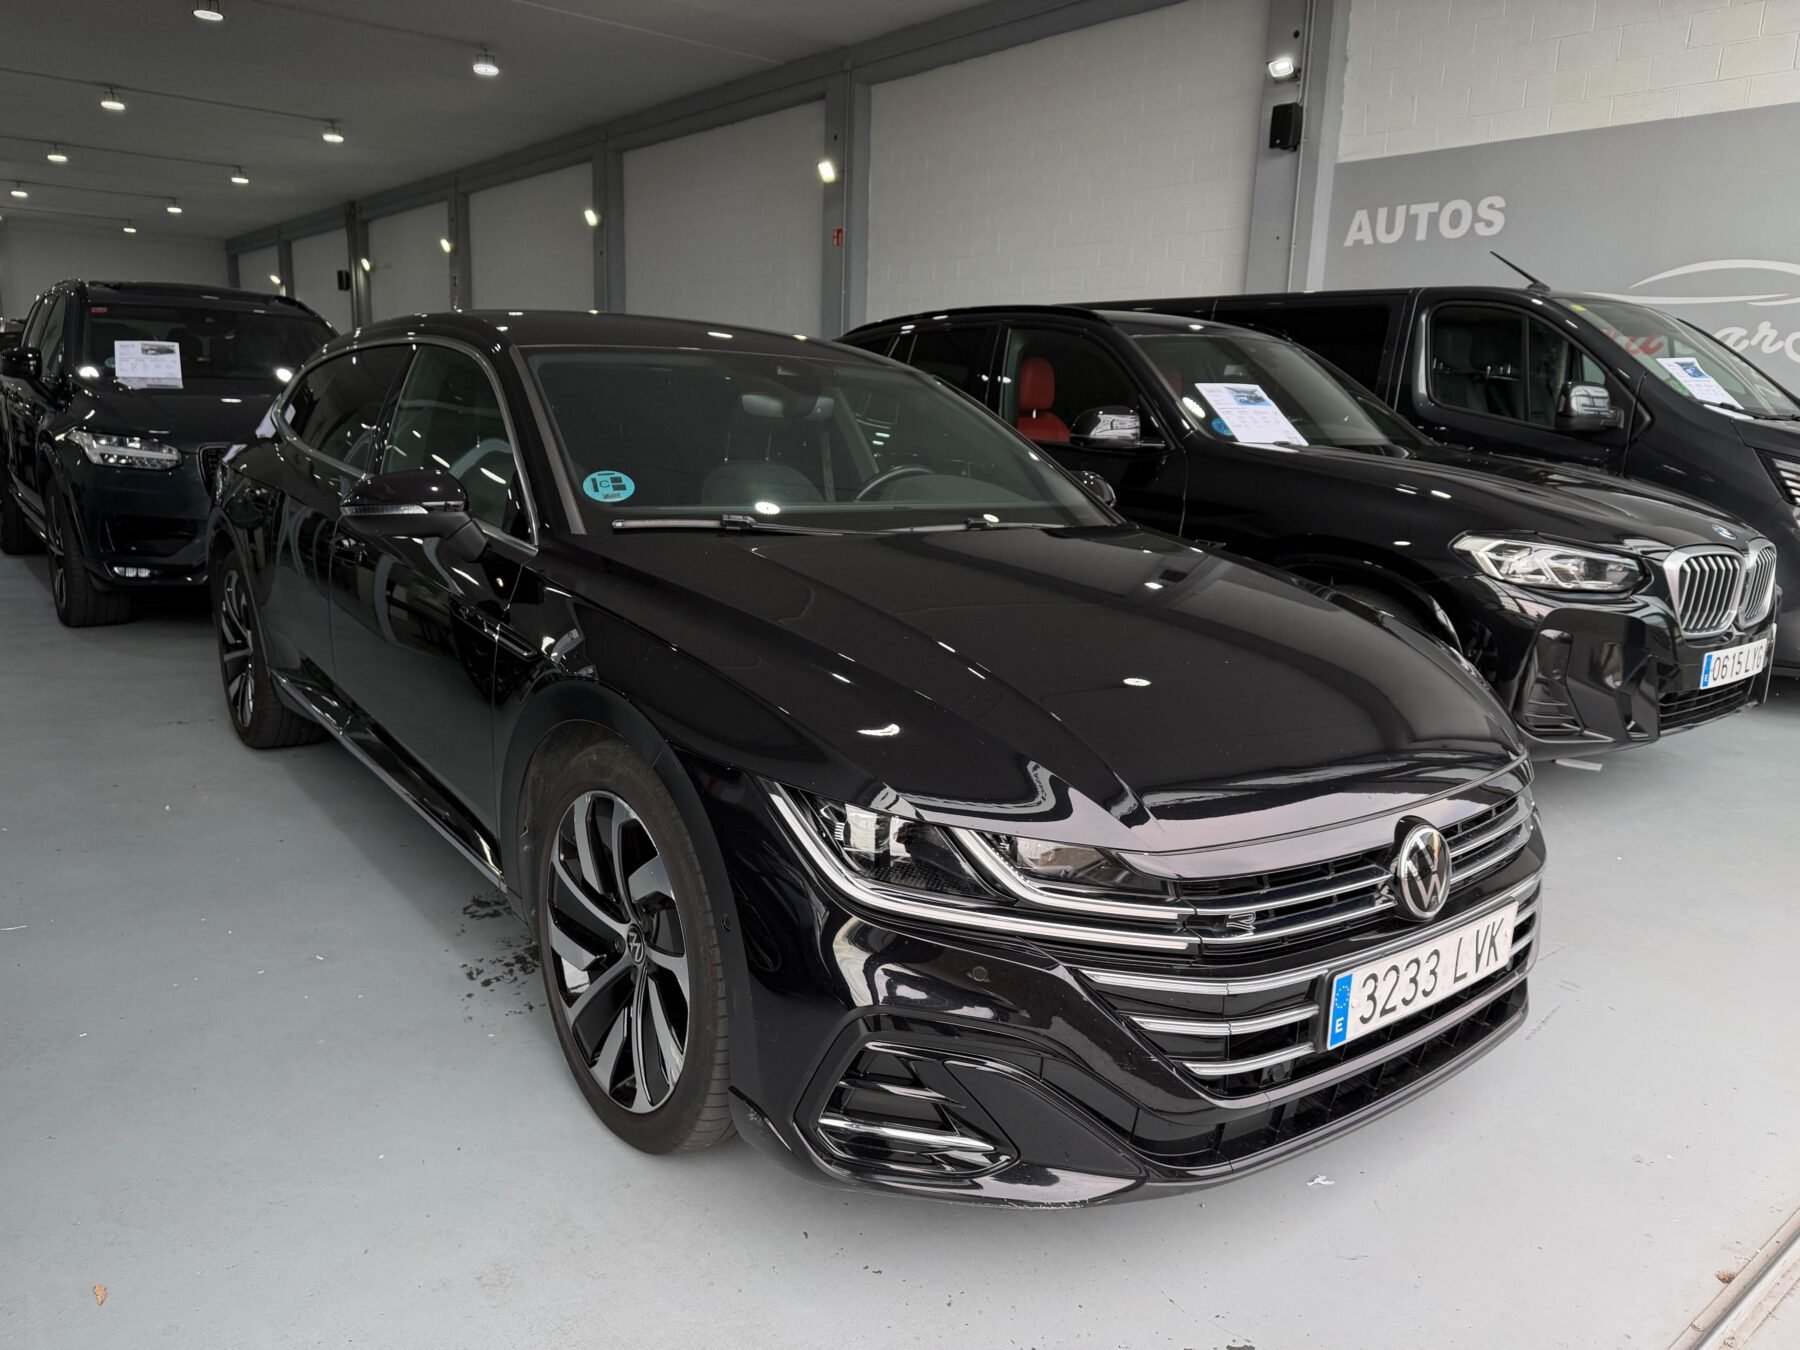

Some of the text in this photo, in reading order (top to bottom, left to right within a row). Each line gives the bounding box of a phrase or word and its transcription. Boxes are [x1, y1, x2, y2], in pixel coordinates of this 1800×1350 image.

[1343, 195, 1507, 247] AUTOS
[1712, 651, 1743, 681] 0615
[1359, 917, 1505, 1025] 3233 LVK
[1334, 1016, 1345, 1034] E
